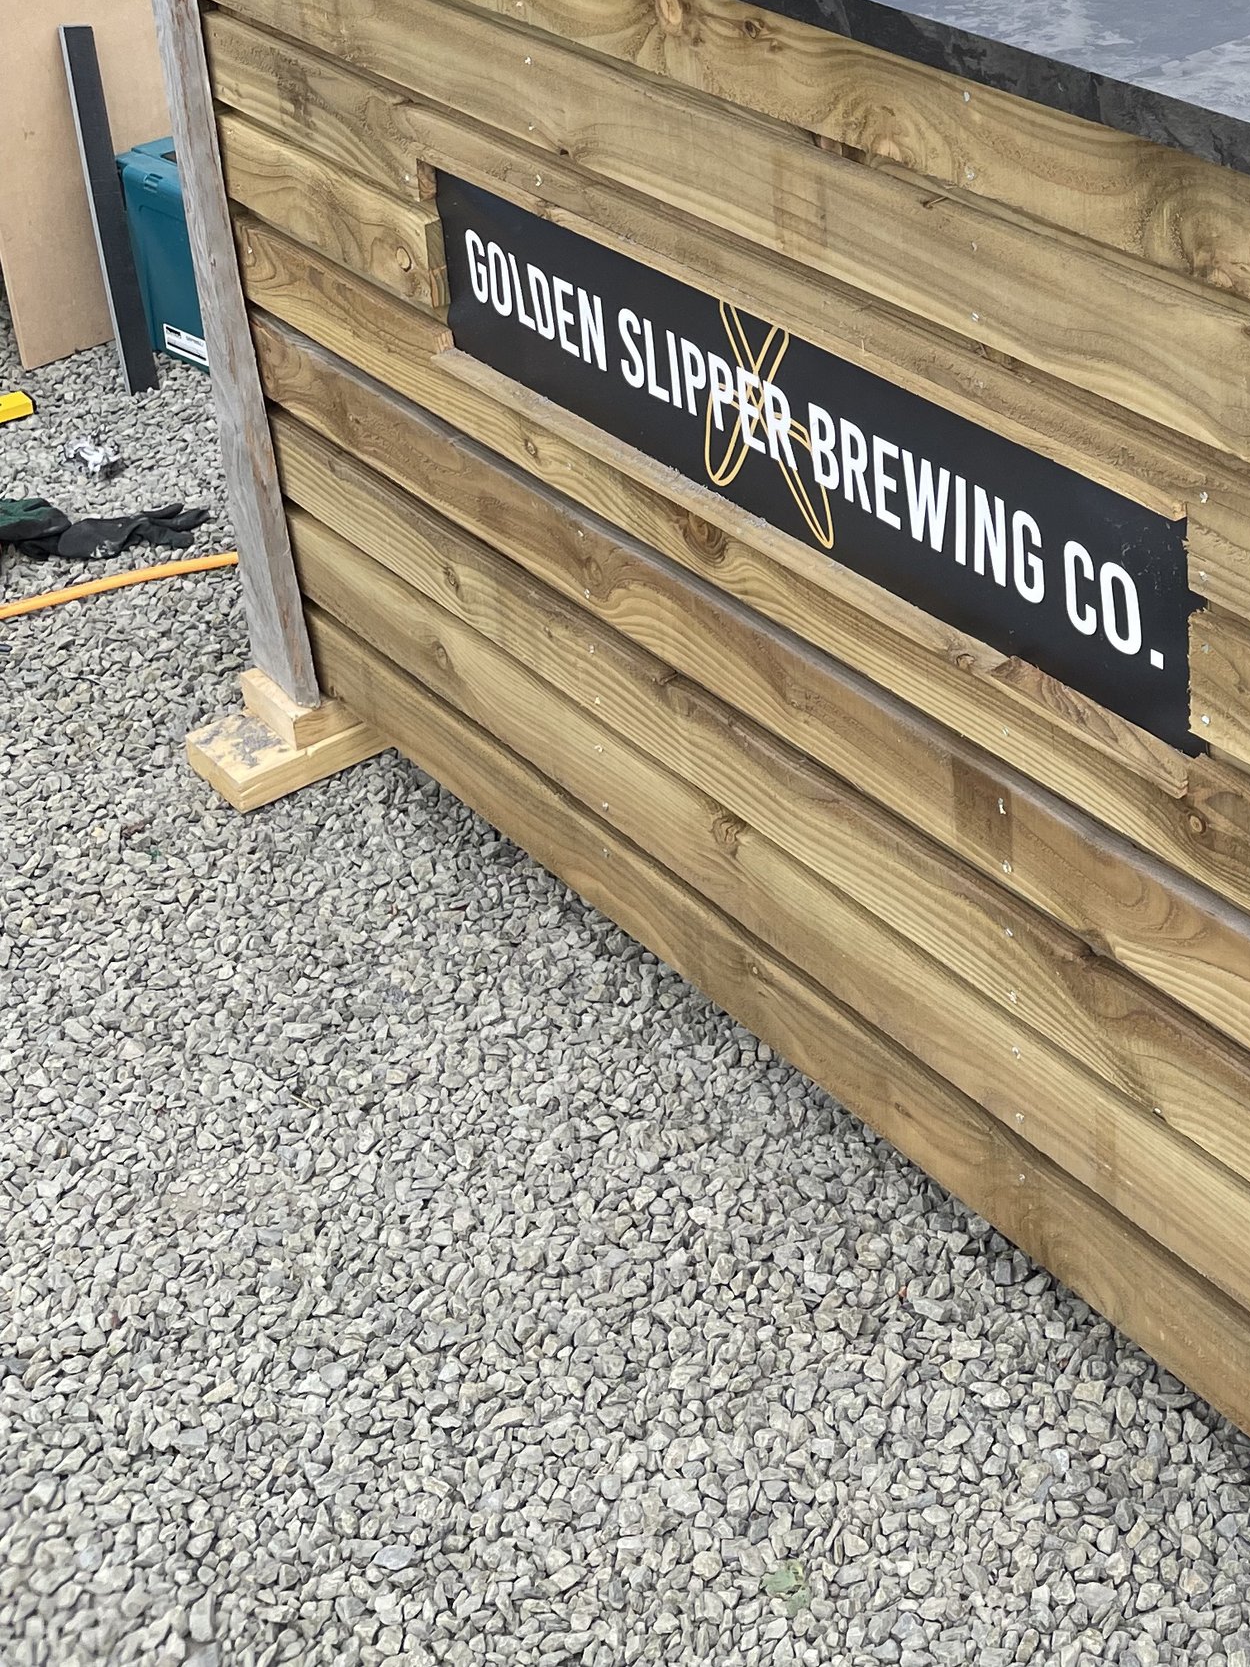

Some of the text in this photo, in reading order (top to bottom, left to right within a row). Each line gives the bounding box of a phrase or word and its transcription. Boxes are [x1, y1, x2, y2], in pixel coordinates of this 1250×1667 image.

[465, 229, 1164, 671] GOLDEN SLIPPER BREWING CO.
